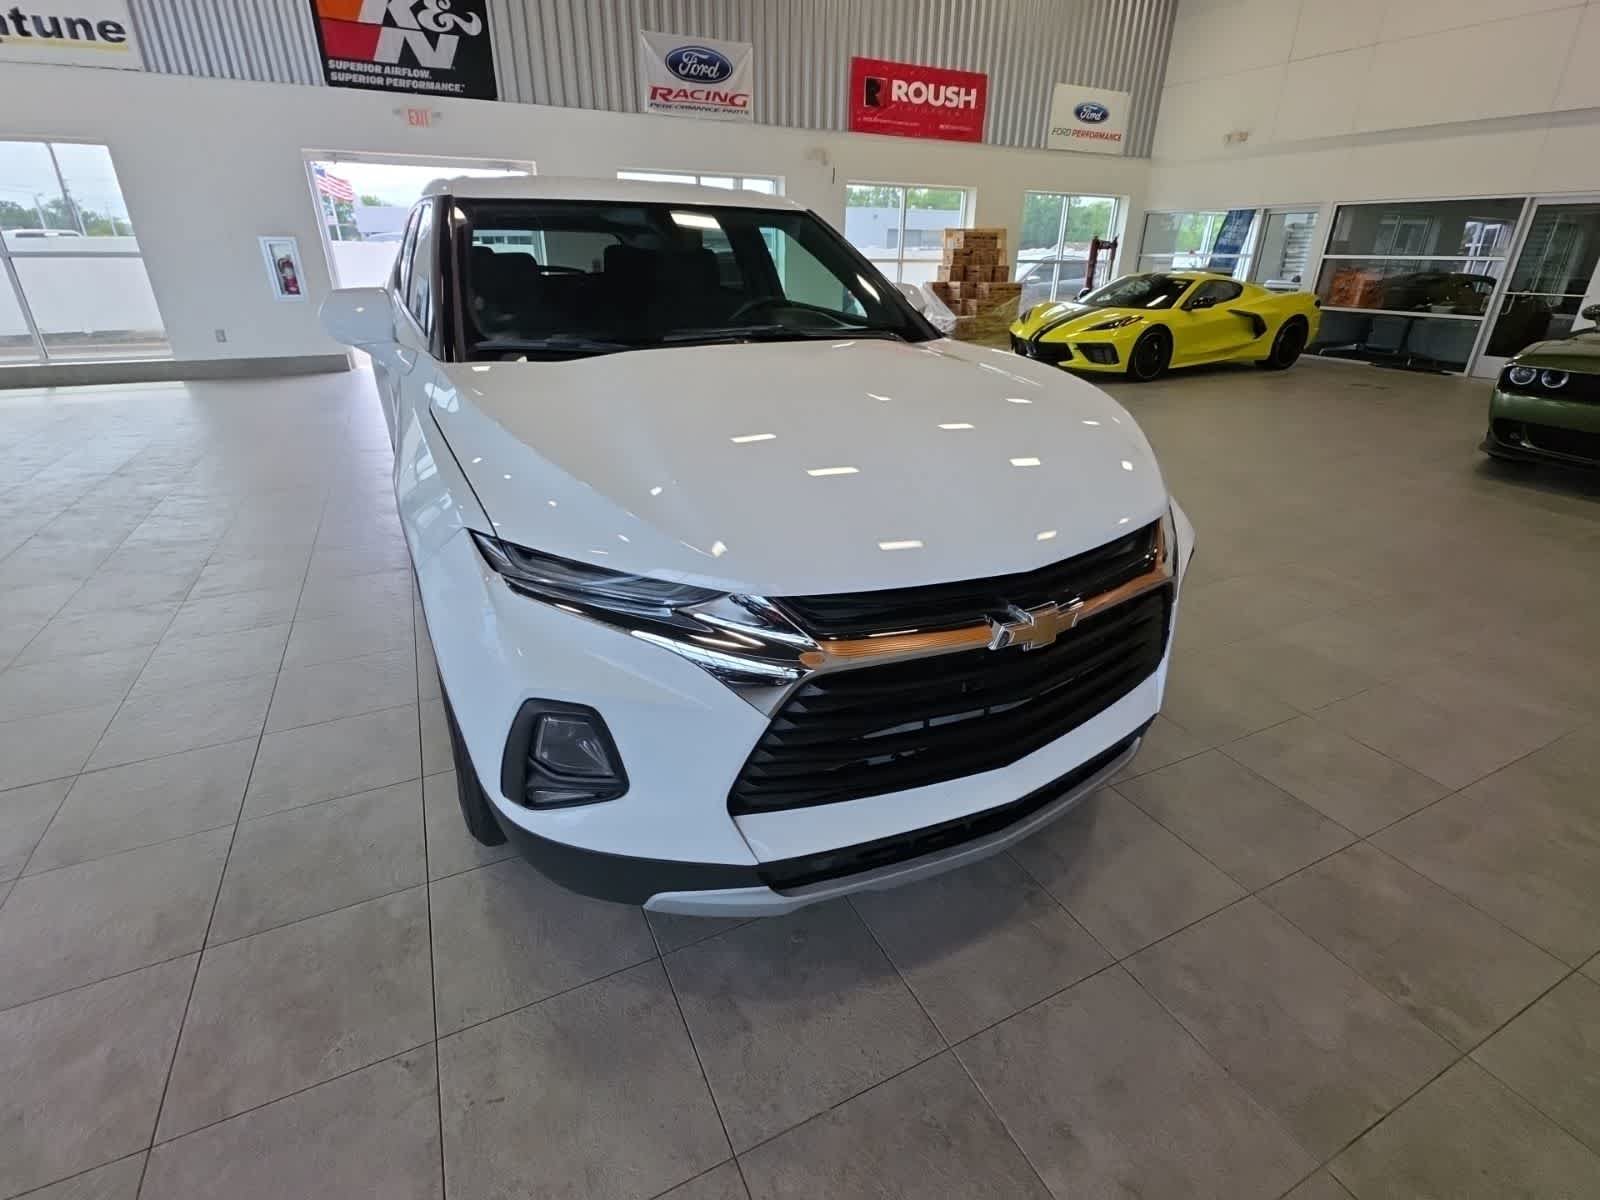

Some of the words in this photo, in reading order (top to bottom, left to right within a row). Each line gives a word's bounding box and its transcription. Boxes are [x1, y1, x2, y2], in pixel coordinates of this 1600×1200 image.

[328, 60, 382, 74] SUPERIOR
[384, 65, 432, 80] AIRFLOW.
[679, 51, 720, 78] Ford
[330, 72, 385, 87] SUPERIOR
[650, 86, 749, 108] RACING
[891, 79, 977, 109] ROUSH
[408, 107, 430, 127] EXIT
[1051, 127, 1072, 137] FORD
